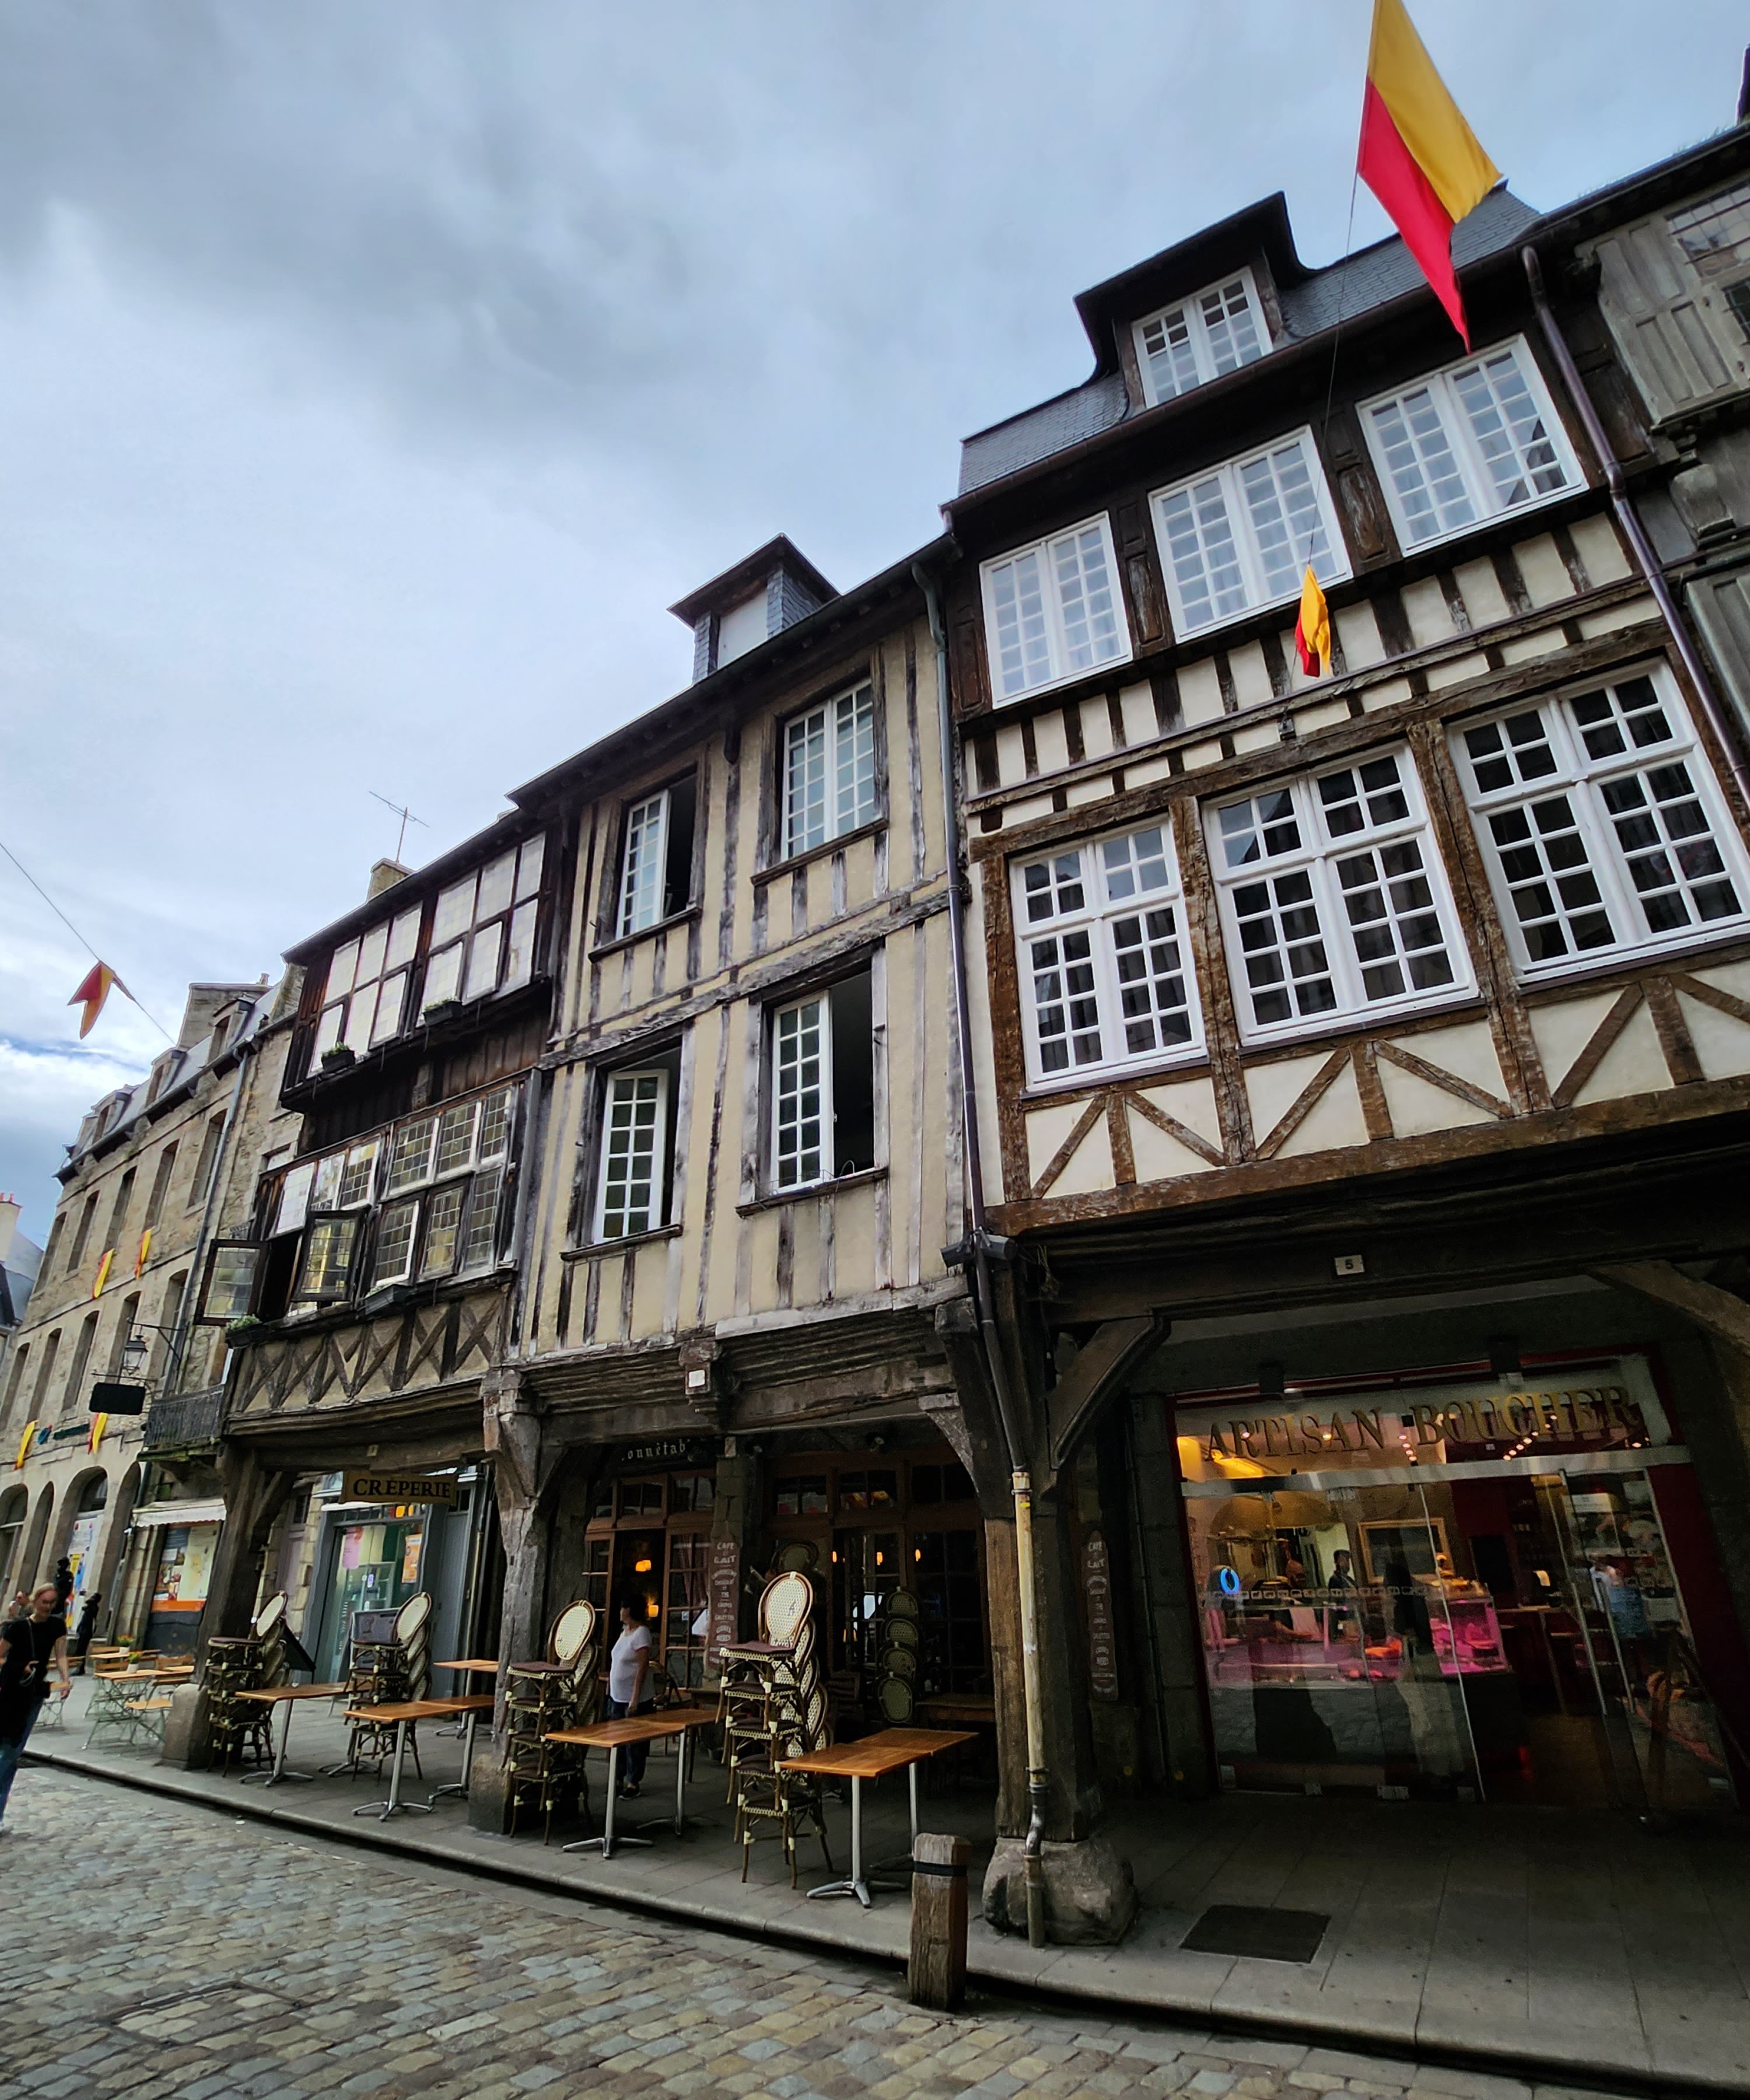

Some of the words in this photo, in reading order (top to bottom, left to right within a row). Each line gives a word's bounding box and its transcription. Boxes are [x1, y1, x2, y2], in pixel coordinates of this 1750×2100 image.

[1345, 1259, 1353, 1269] 5
[1206, 1406, 1384, 1460] ARTISAN
[1409, 1385, 1640, 1445] BOUCHER
